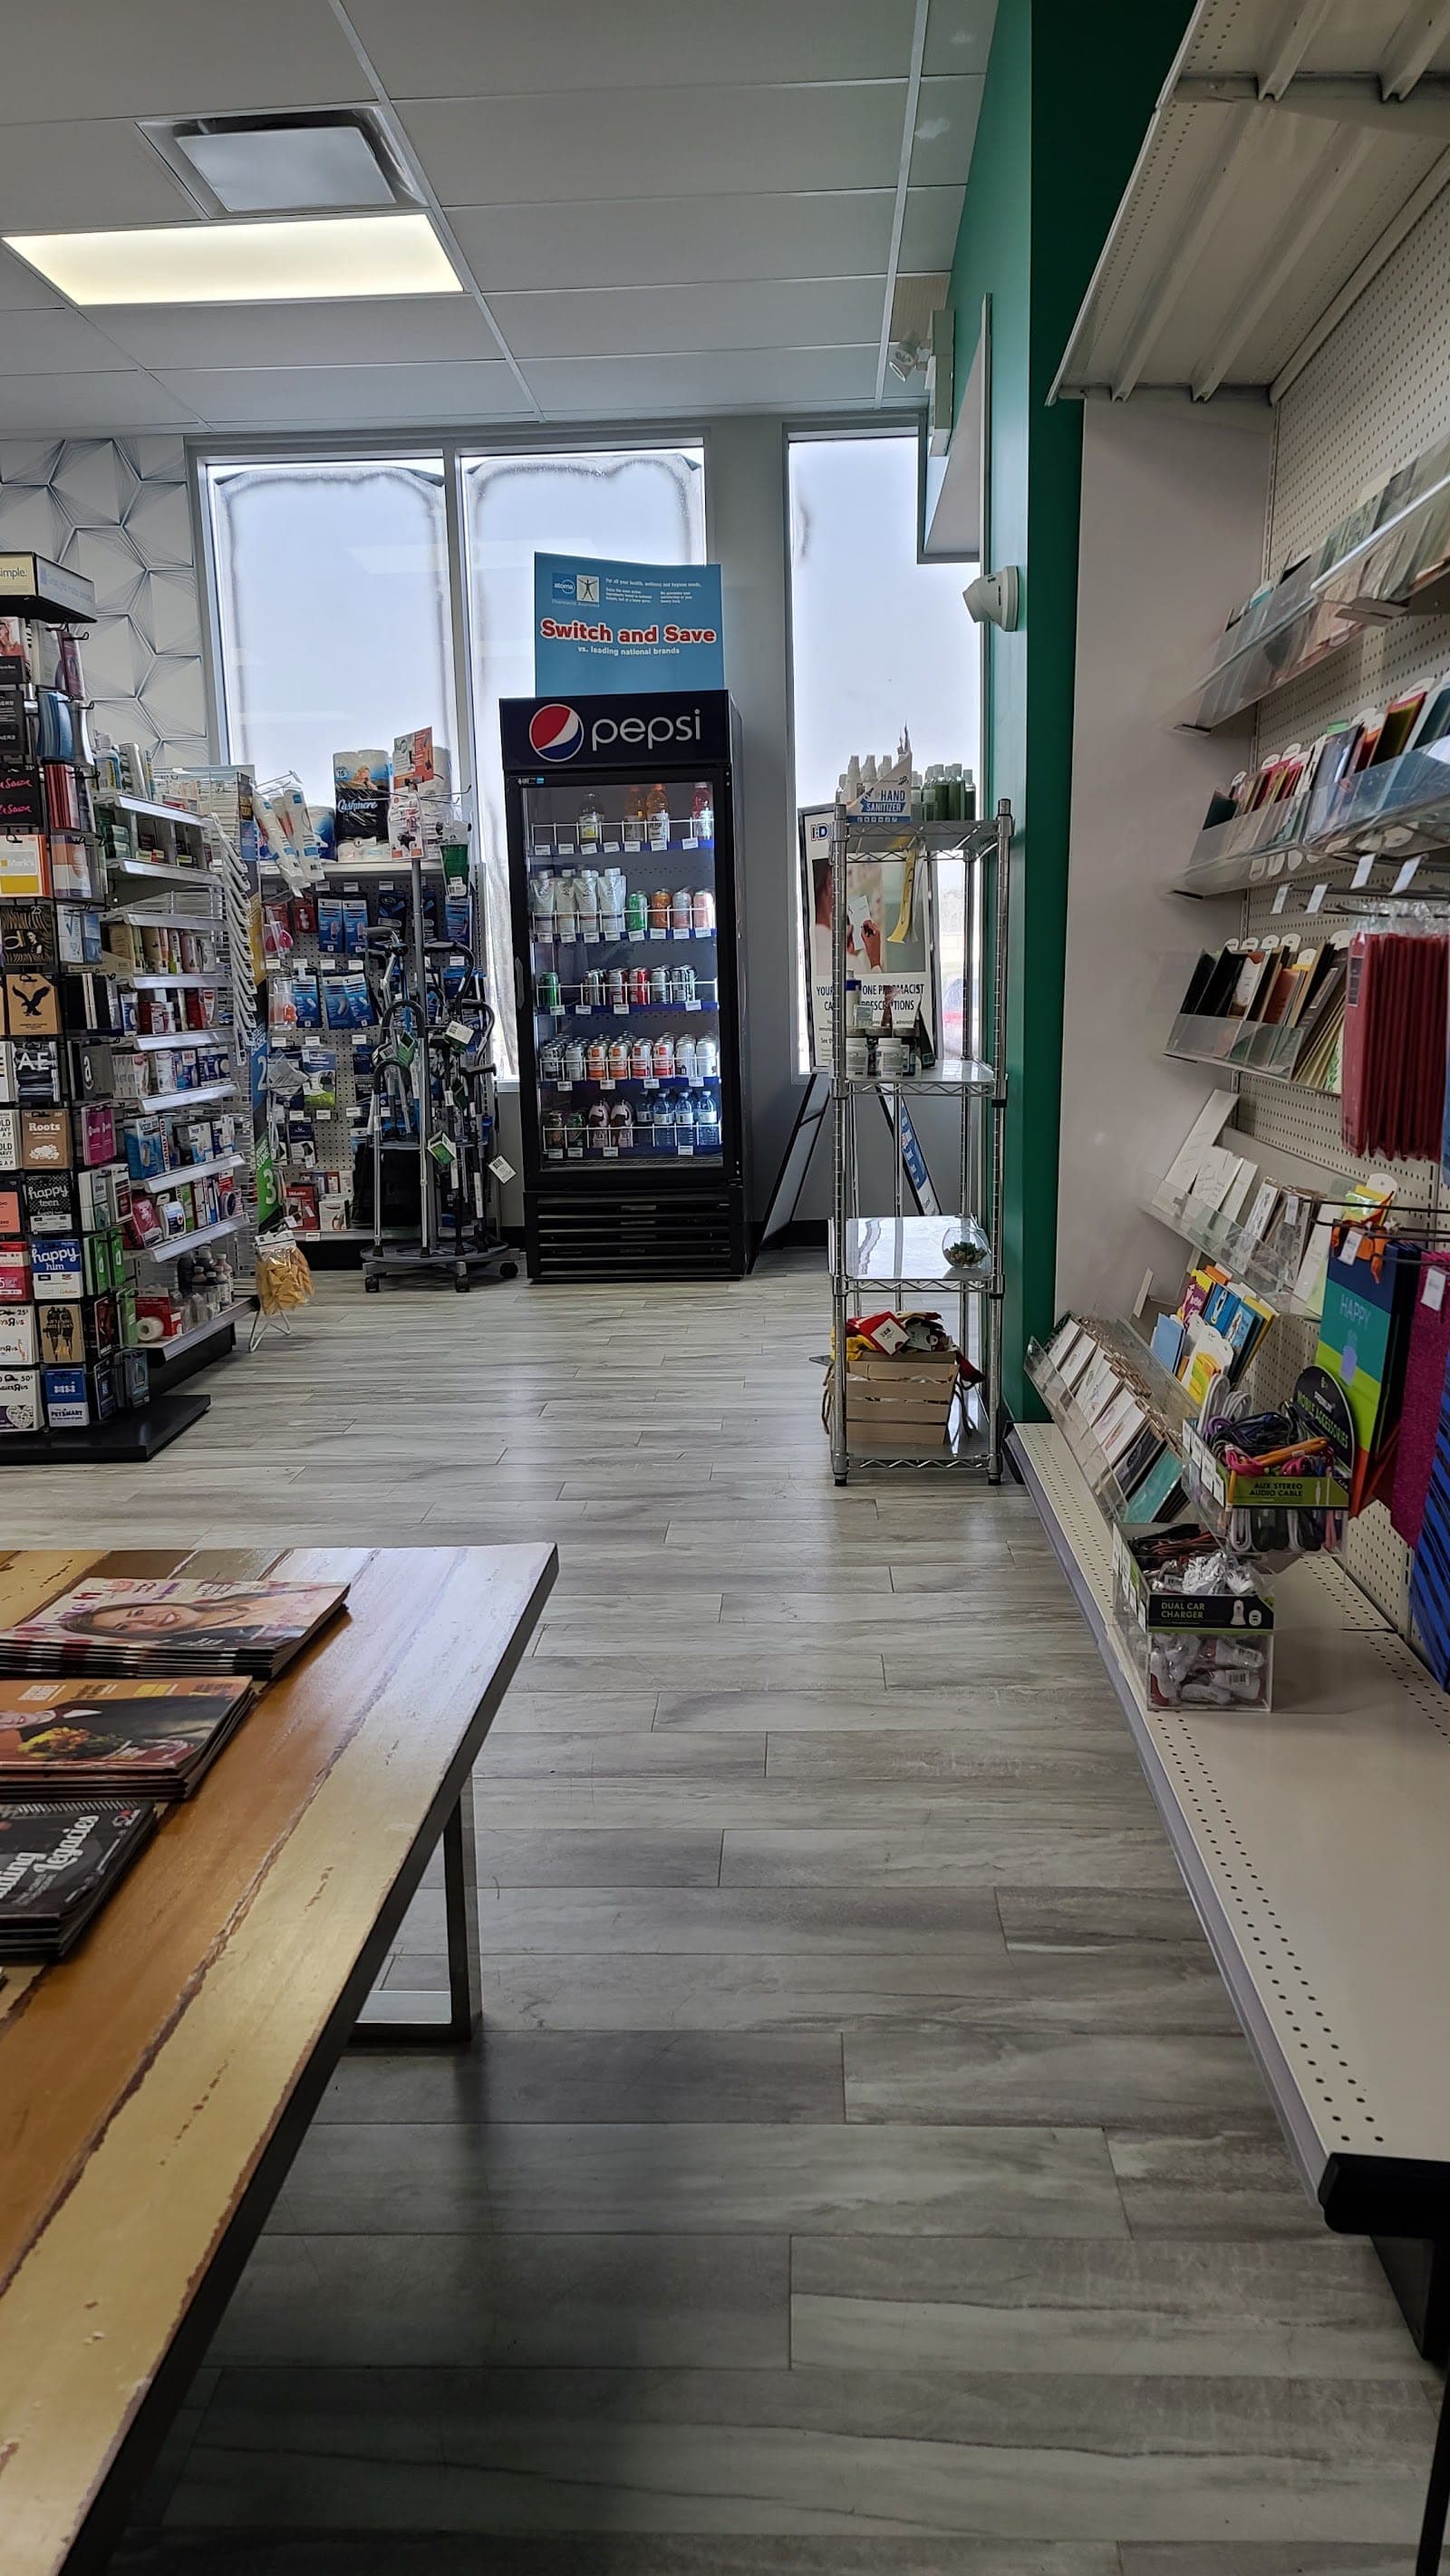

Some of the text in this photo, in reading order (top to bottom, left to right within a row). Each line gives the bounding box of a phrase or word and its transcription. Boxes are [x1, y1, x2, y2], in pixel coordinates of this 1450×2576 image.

[541, 617, 717, 644] Switch and Save
[590, 645, 619, 657] leading
[621, 647, 652, 655] national
[652, 646, 680, 654] brands
[592, 709, 701, 751] pepsi
[880, 789, 905, 802] HAND
[337, 799, 378, 813] Cashmere
[866, 802, 902, 812] SANITIZER
[862, 984, 877, 995] ONE
[878, 983, 924, 995] PMACIST
[824, 1001, 834, 1012] CA
[17, 1051, 50, 1071] AE
[257, 1054, 267, 1090] 2
[28, 1122, 62, 1132] Roots
[27, 1185, 69, 1199] happy
[263, 1167, 277, 1205] 3
[39, 1198, 60, 1207] teen
[31, 1247, 81, 1264] happy
[45, 1263, 65, 1271] him
[1339, 1293, 1372, 1331] HAPPY
[1273, 1482, 1303, 1490] STEREO
[1278, 1489, 1302, 1497] CABLE
[1161, 1602, 1205, 1611] DUAL CAR
[1161, 1610, 1204, 1619] CHARGER
[33, 1815, 101, 1874] Legacies
